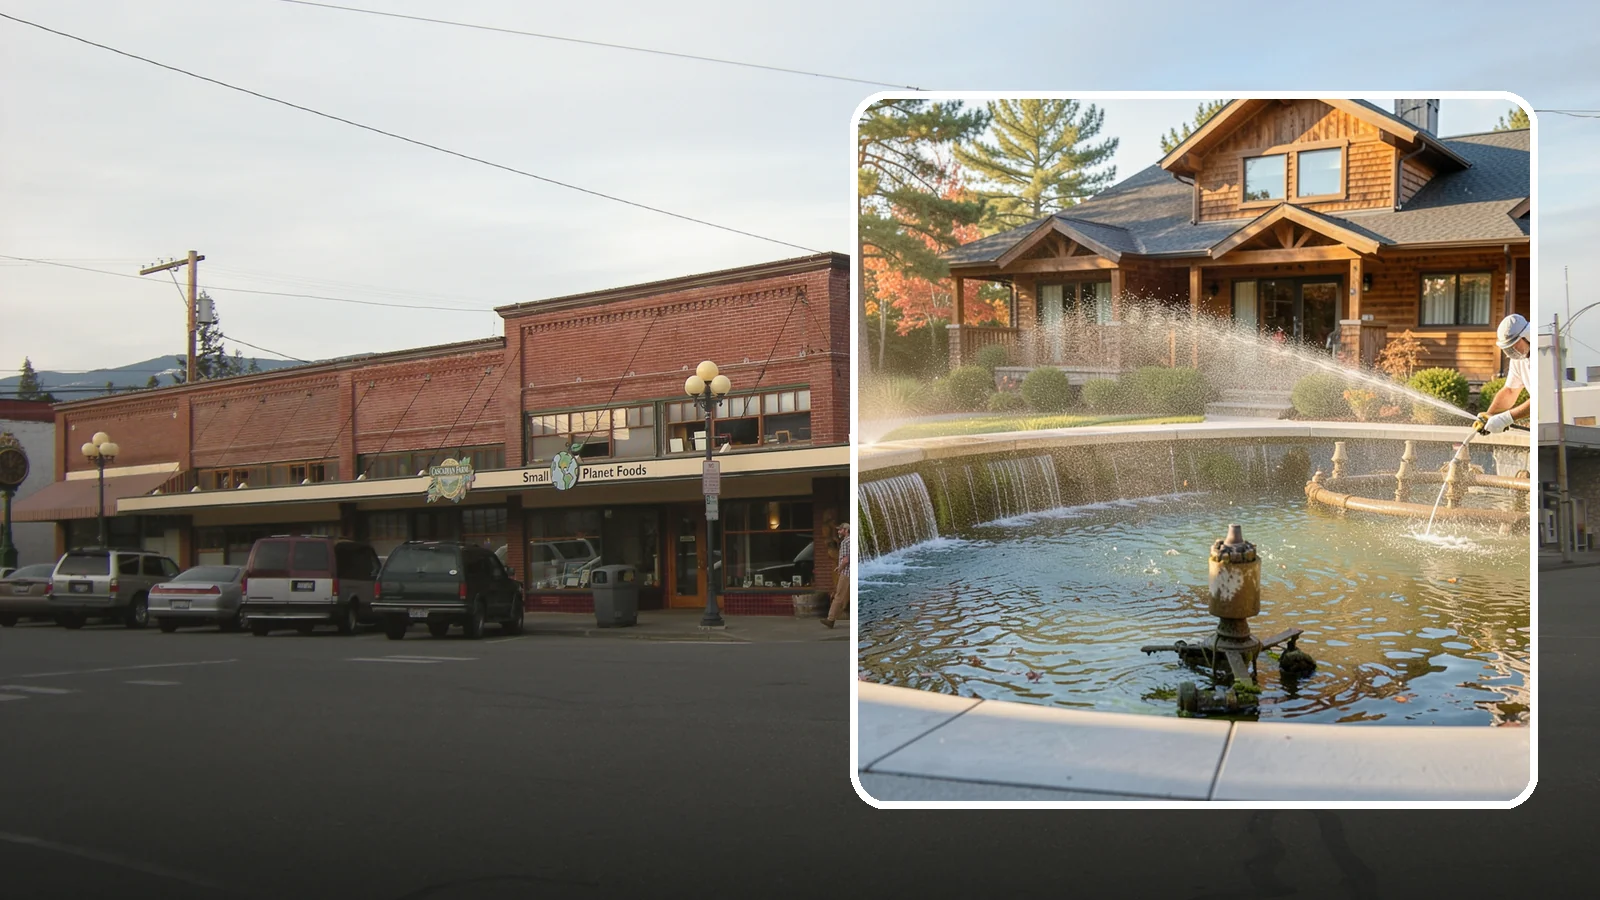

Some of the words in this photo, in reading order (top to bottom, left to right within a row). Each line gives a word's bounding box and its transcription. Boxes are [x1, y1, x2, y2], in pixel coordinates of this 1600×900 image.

[431, 467, 456, 476] CASCADIAN
[456, 465, 469, 474] FARM
[523, 471, 549, 483] Small
[582, 467, 614, 479] Planet
[616, 464, 647, 477] Foods
